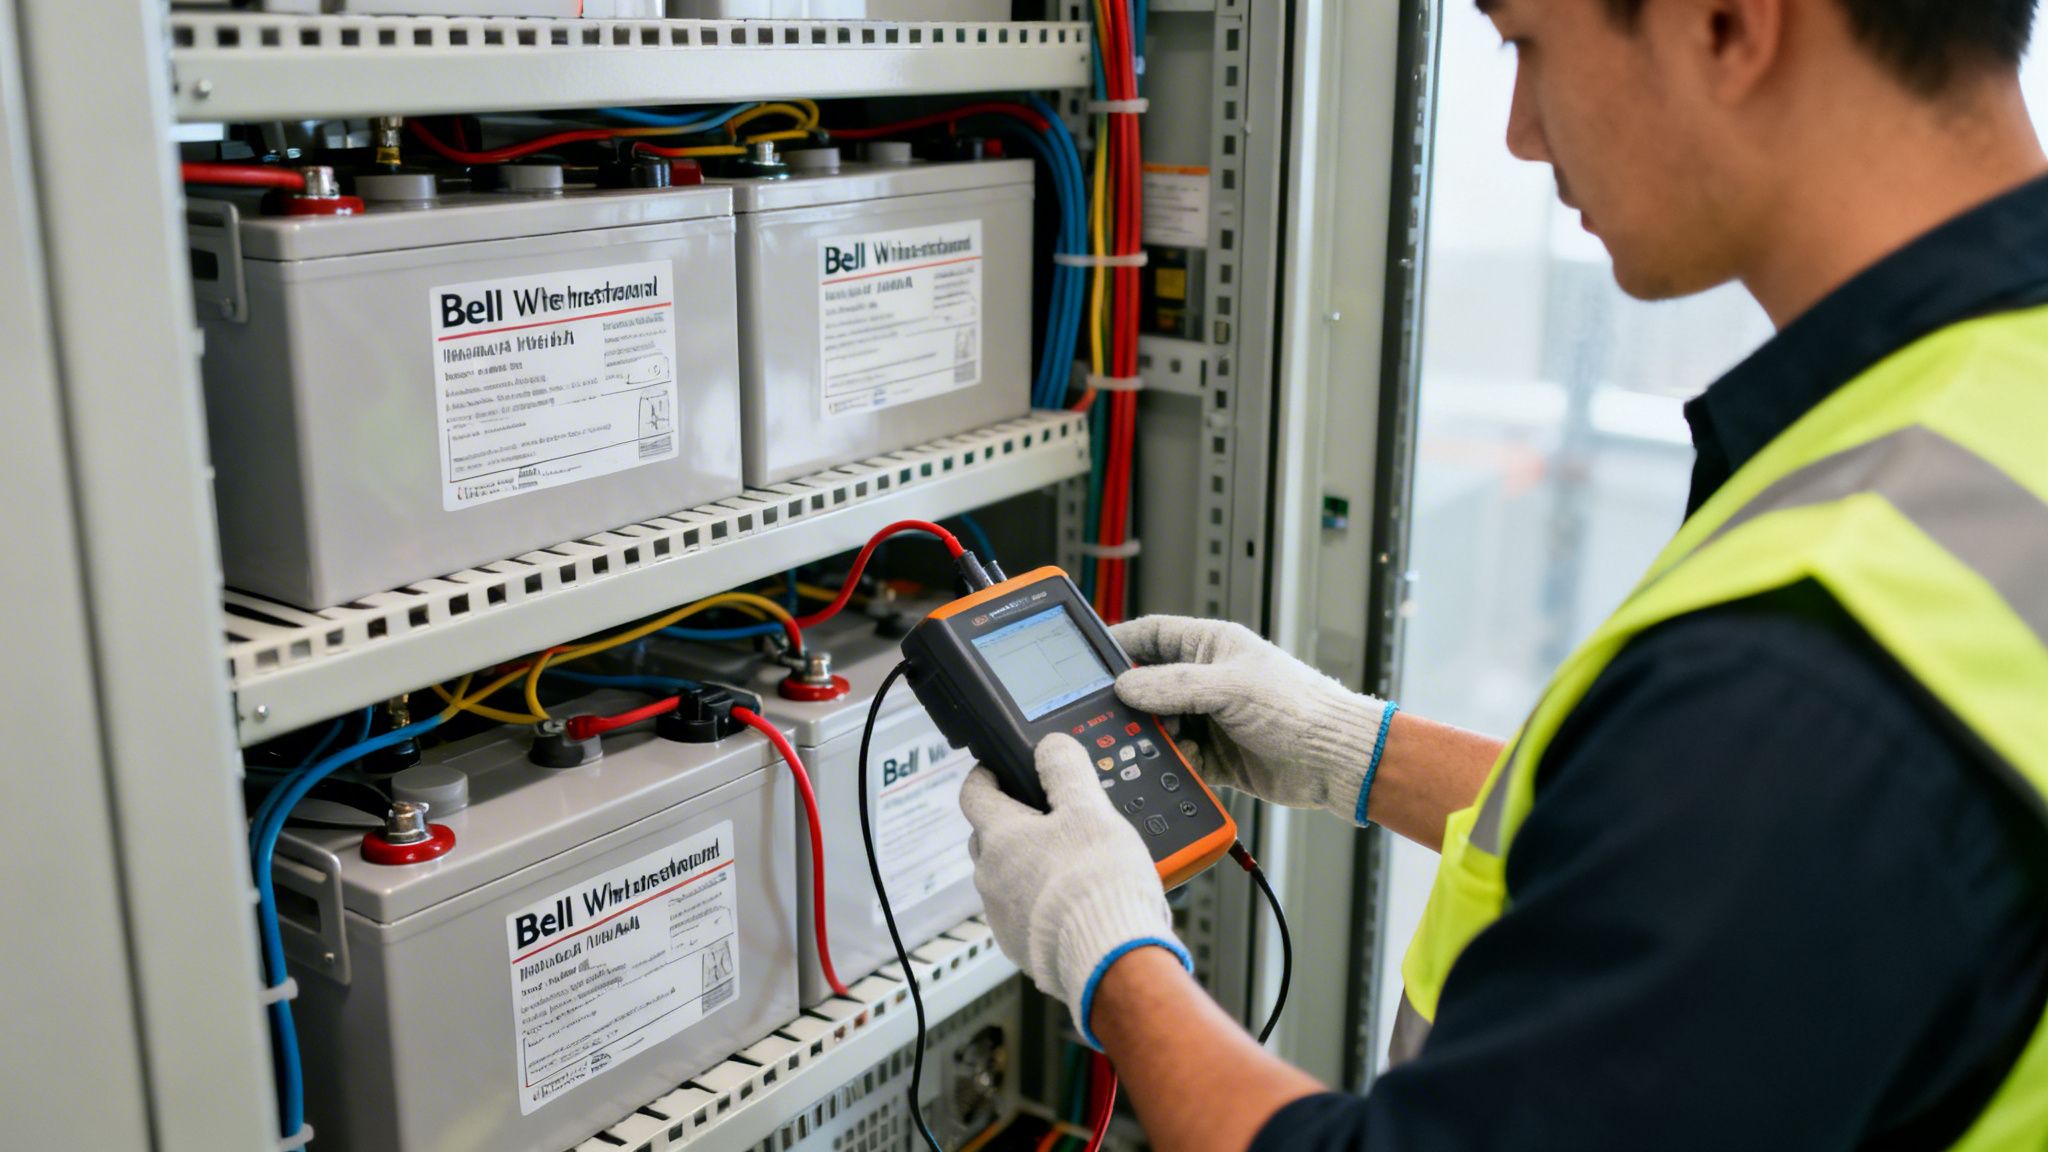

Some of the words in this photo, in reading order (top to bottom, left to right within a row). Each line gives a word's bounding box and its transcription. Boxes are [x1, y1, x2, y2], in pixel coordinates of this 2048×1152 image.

[825, 242, 866, 275] Bell
[441, 289, 503, 328] Bell
[883, 748, 919, 787] Bell
[515, 896, 574, 950] Bell
